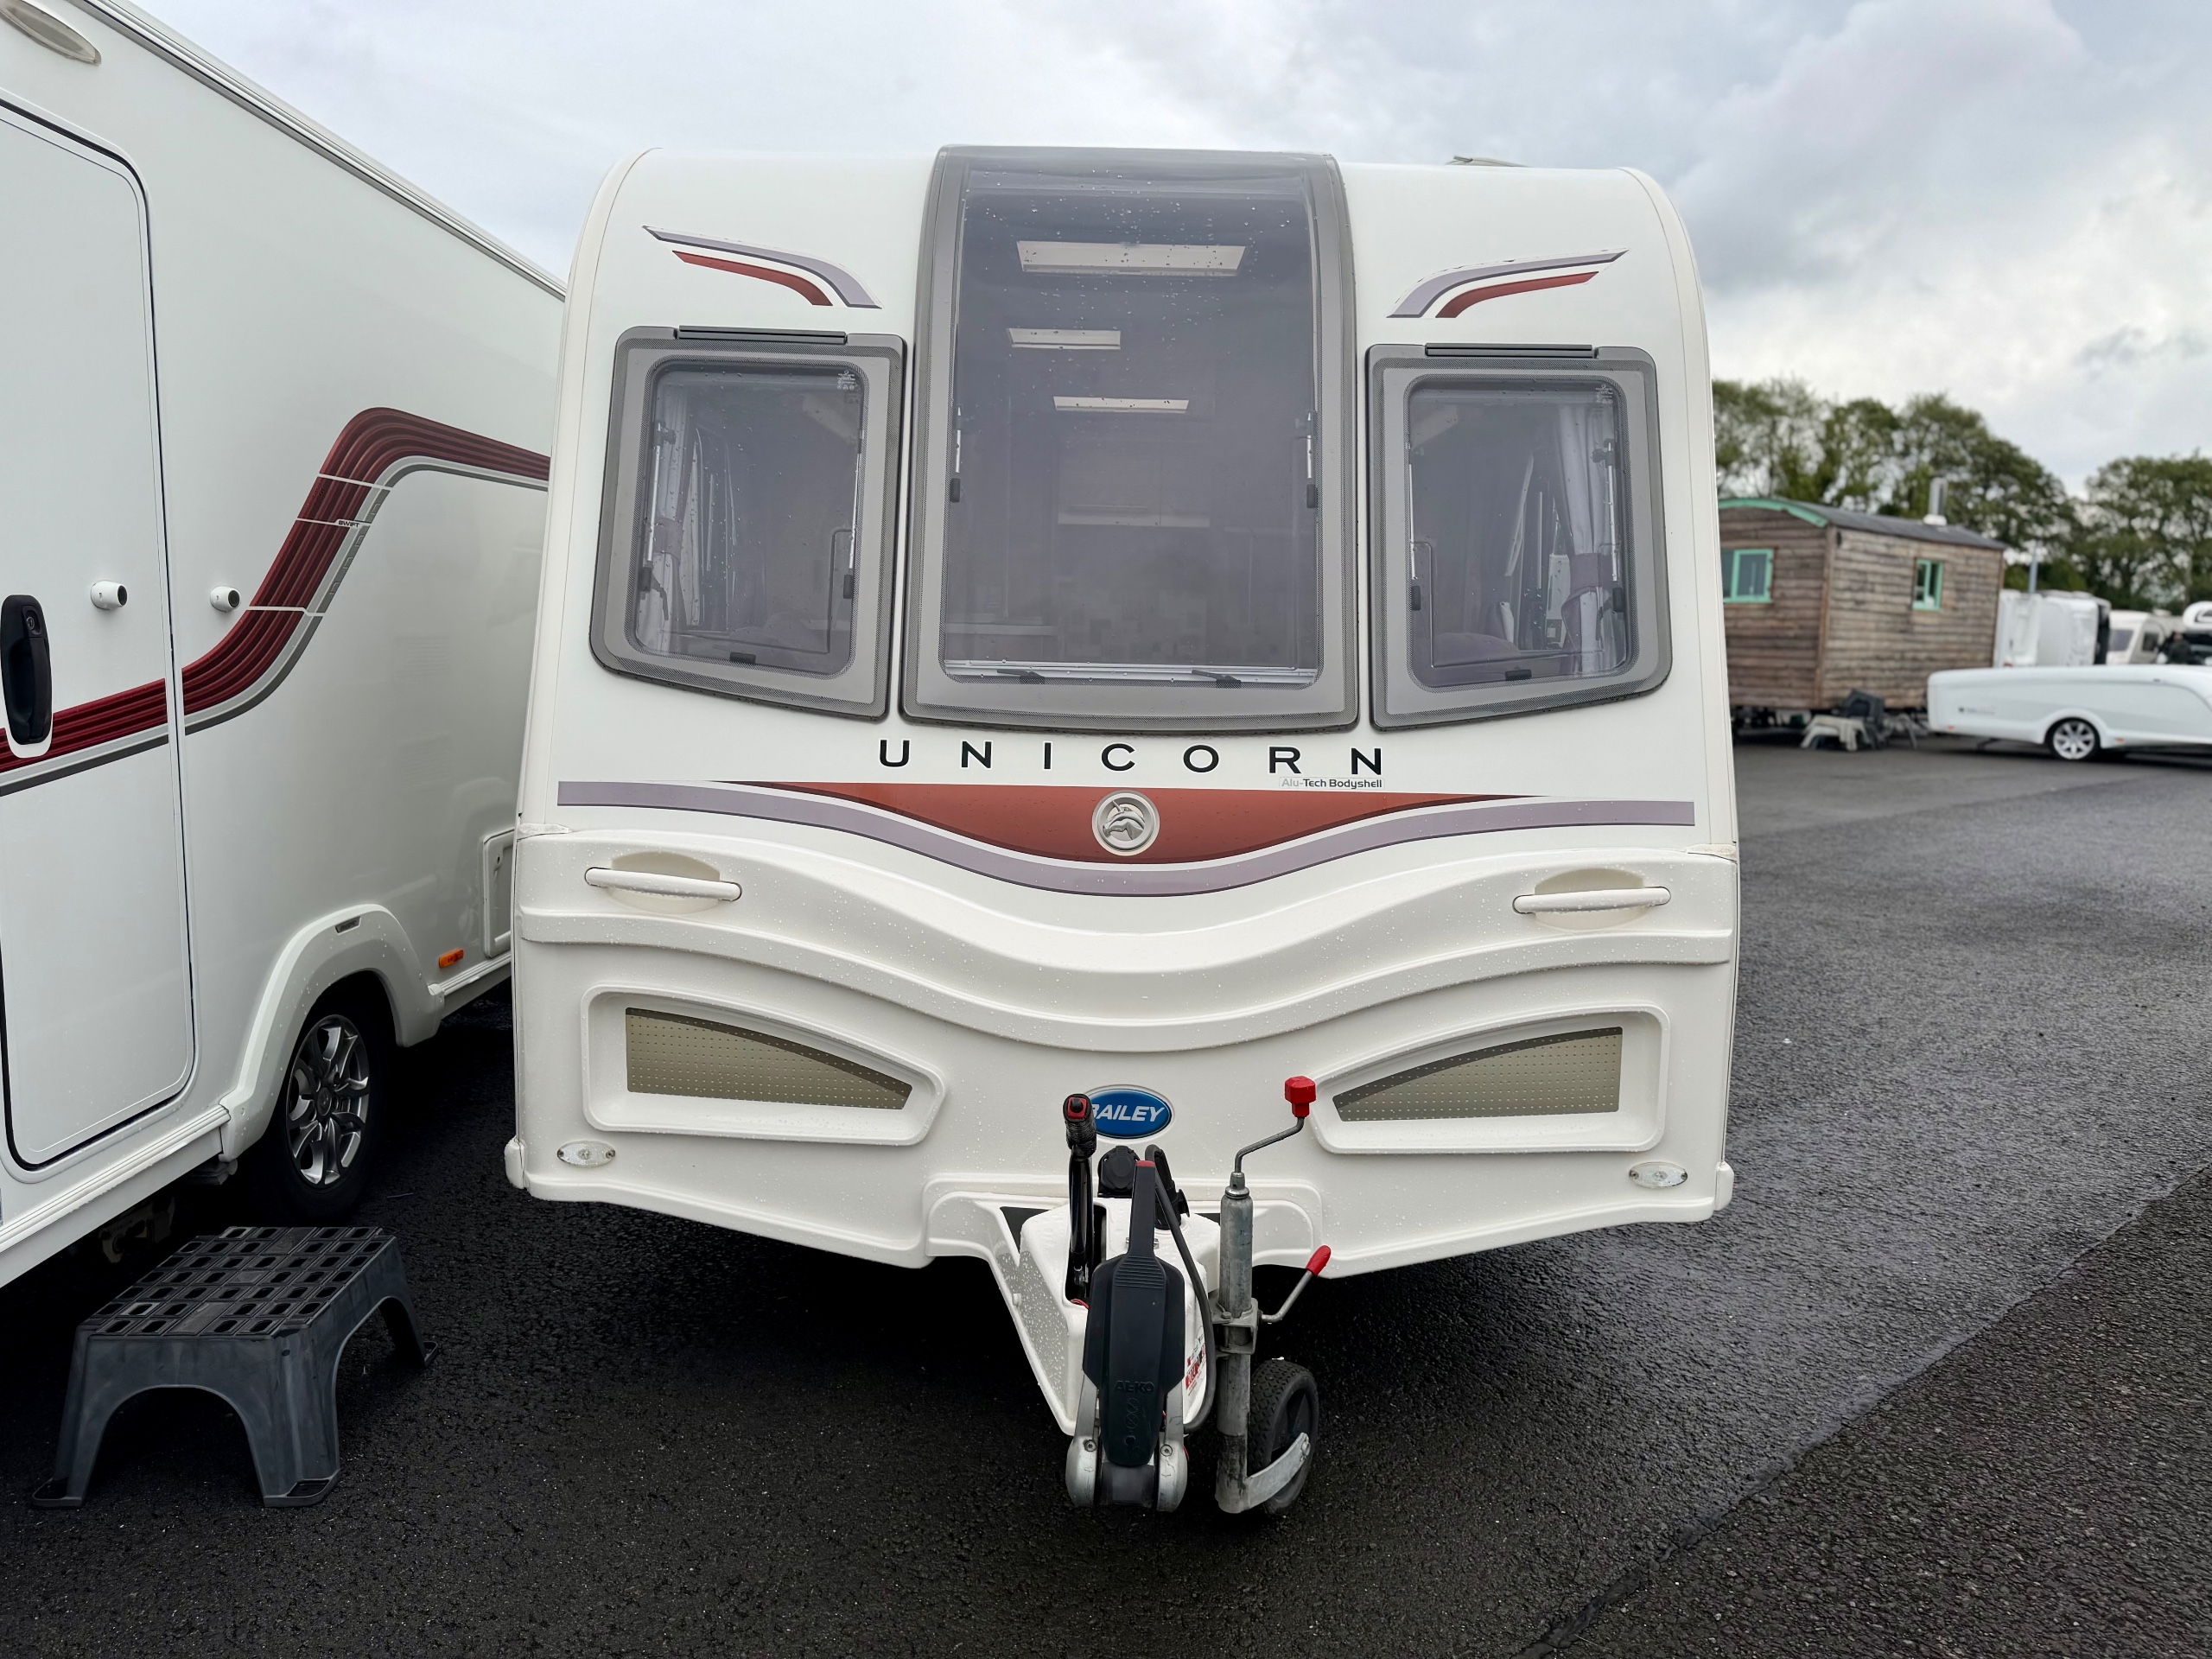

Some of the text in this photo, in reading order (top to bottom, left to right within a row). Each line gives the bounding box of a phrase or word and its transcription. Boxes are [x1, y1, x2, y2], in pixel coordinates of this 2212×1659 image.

[880, 740, 1381, 774] UNICORN
[1281, 778, 1382, 789] Alu-Tech Bodyshell
